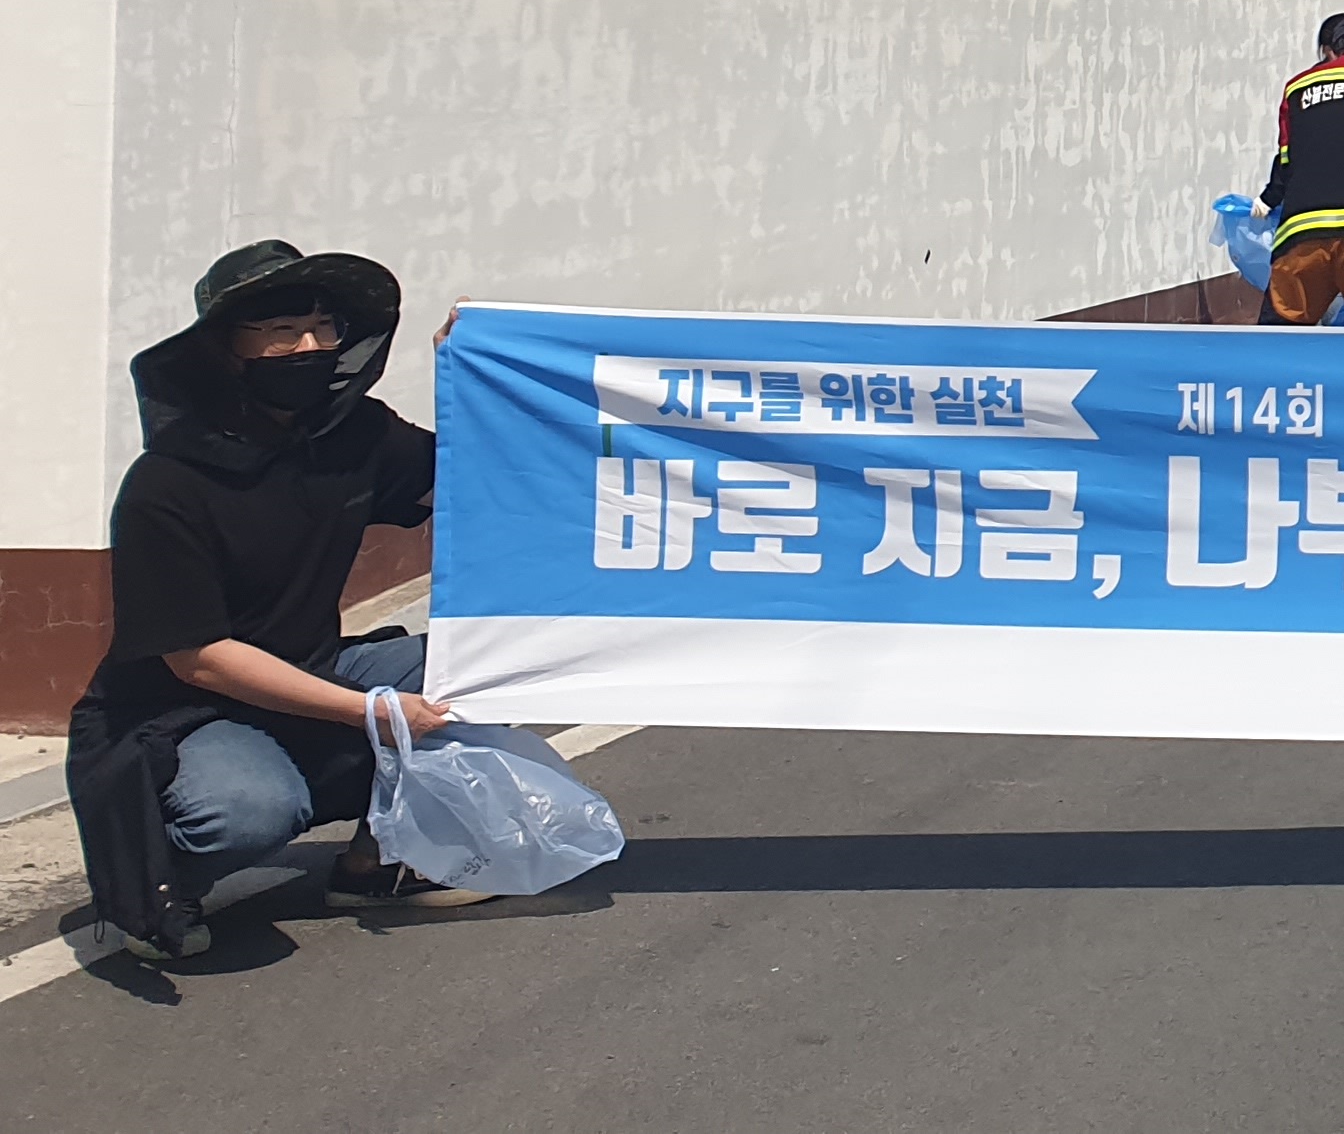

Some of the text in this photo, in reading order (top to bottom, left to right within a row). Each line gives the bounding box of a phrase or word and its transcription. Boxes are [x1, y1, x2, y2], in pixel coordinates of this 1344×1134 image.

[657, 369, 1024, 427] 지구를 위한 실천
[1176, 382, 1325, 437] 제14회
[593, 457, 822, 574] 바로
[862, 468, 1121, 597] 지금,
